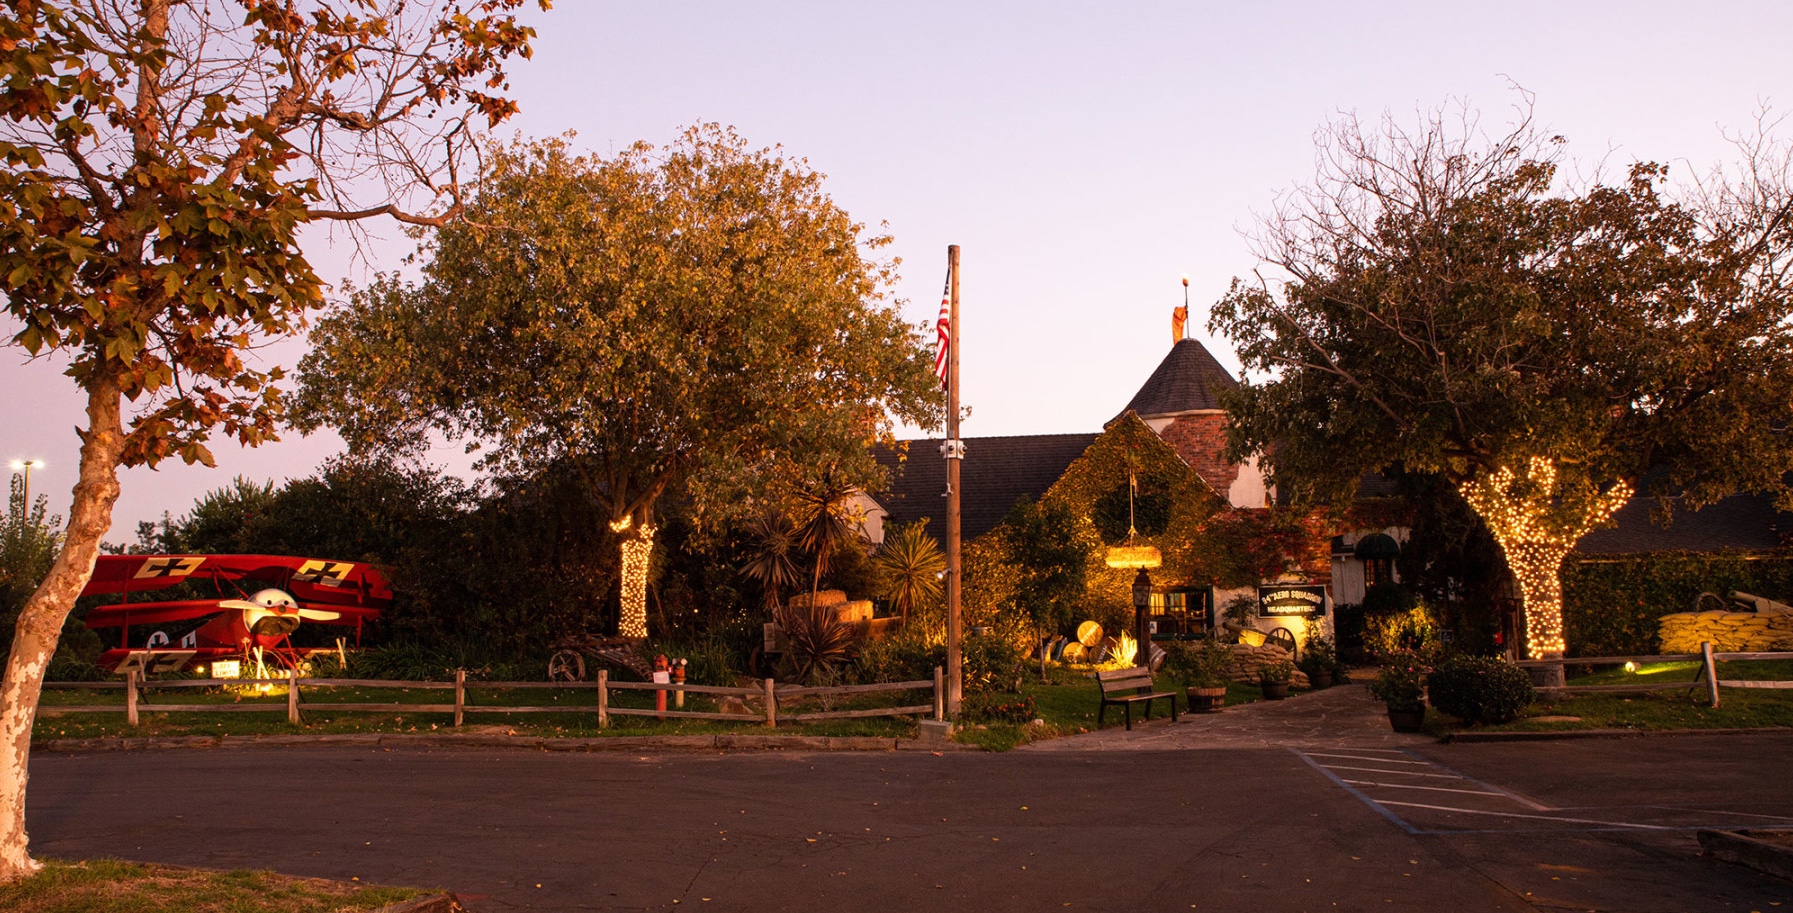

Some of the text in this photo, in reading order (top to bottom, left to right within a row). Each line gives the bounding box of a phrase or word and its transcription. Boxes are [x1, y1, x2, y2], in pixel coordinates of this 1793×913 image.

[1273, 590, 1290, 600] AERO
[1291, 590, 1323, 604] SQUADRON
[1267, 605, 1316, 613] HEADQUARTERS
